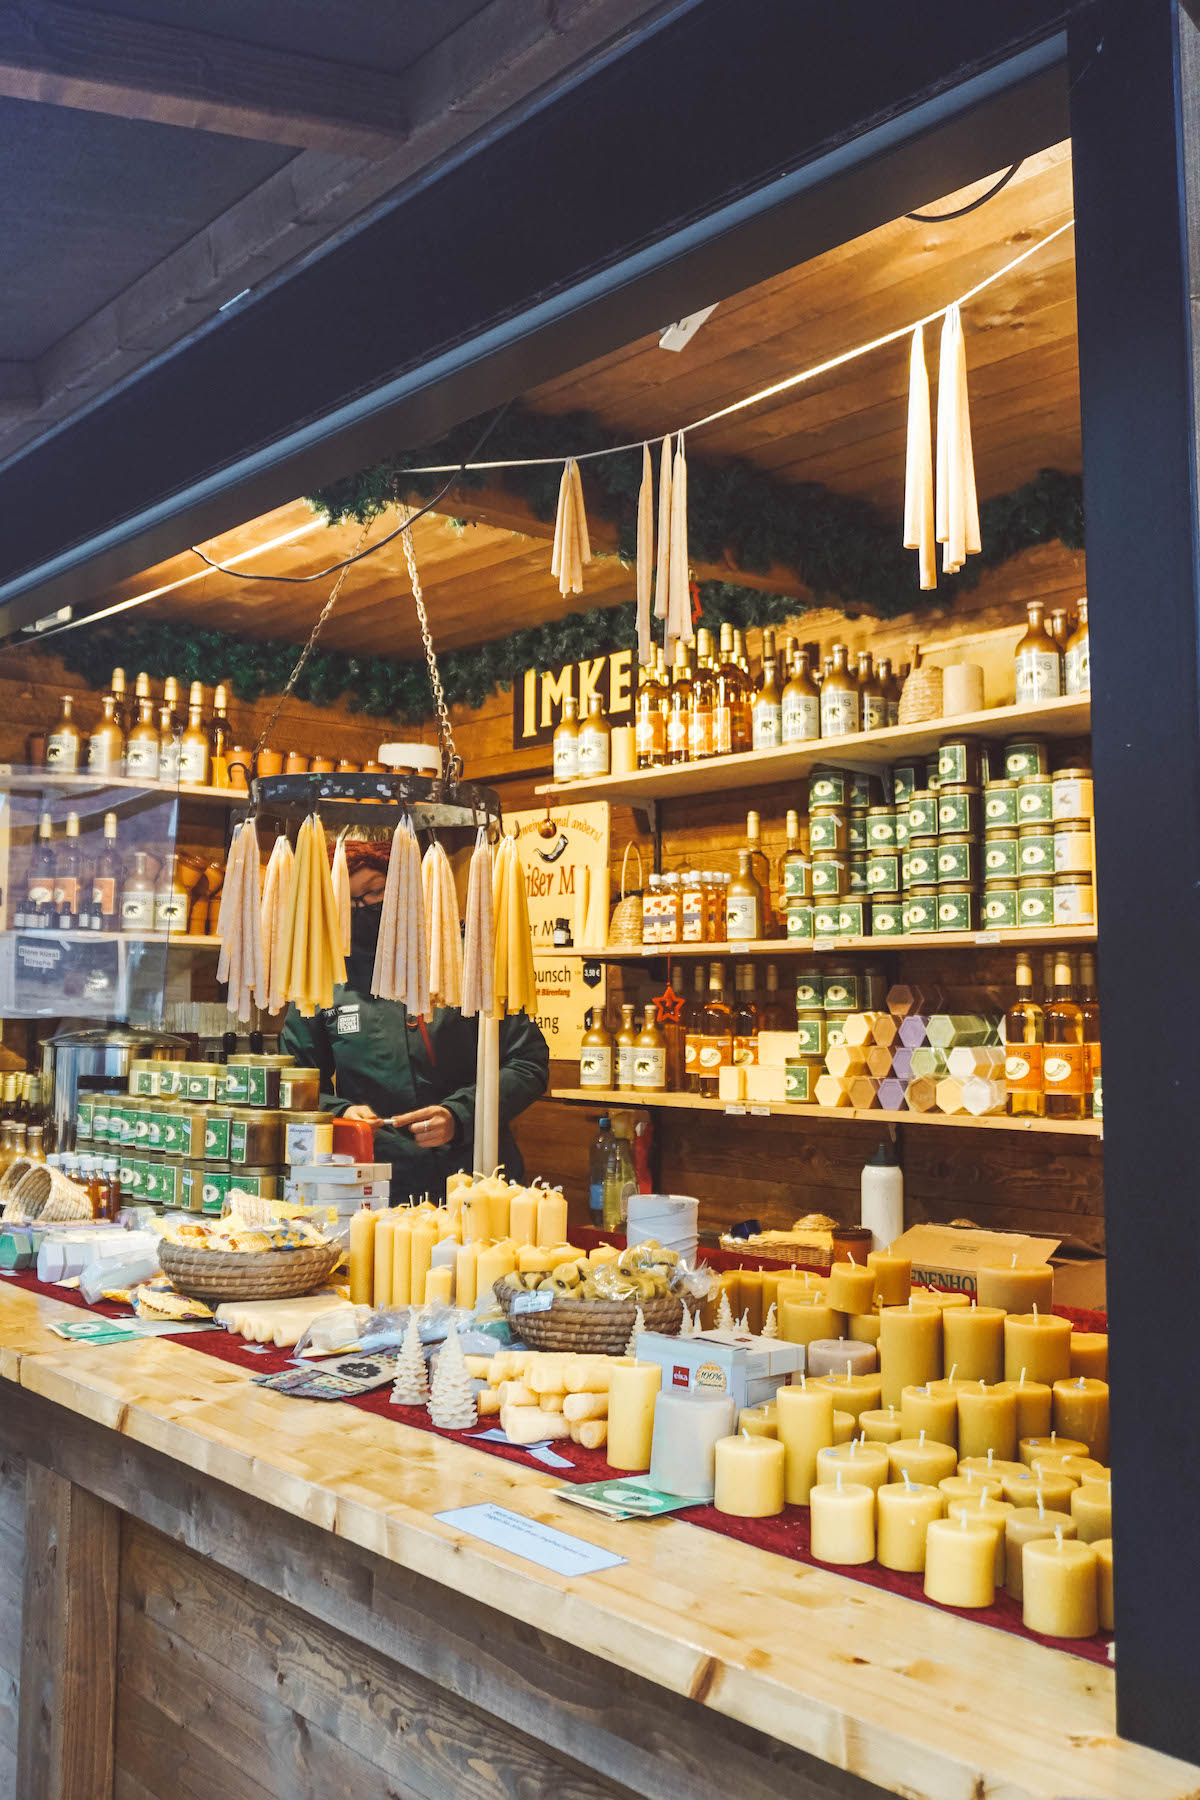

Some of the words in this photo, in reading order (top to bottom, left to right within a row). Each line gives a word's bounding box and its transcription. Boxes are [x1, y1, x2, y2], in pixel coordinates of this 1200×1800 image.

[522, 649, 647, 737] IMKE
[526, 863, 554, 898] ißer
[700, 1371, 723, 1381] 100%
